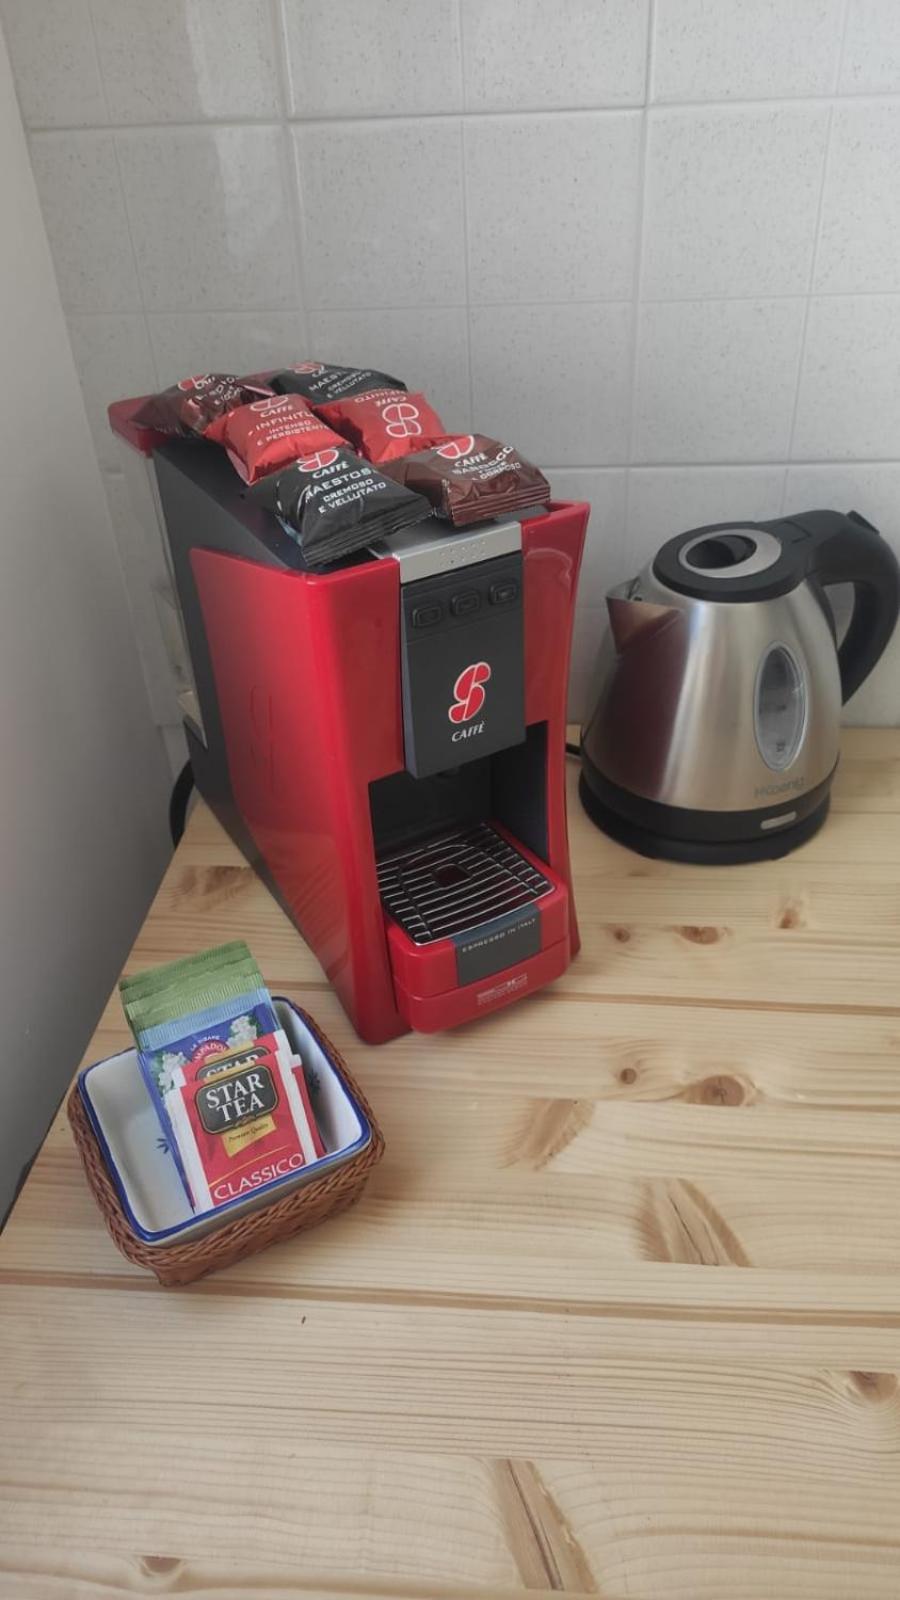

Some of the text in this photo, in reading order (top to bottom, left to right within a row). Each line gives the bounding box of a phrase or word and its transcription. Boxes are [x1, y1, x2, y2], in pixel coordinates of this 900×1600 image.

[269, 419, 311, 434] INTENSO
[318, 482, 386, 513] E VELLUTATO
[323, 478, 374, 502] CREMOSO
[451, 720, 485, 742] CAFFÈ
[205, 1073, 264, 1109] STAR
[216, 1092, 265, 1122] TEA
[213, 1153, 304, 1199] CLASSICO
